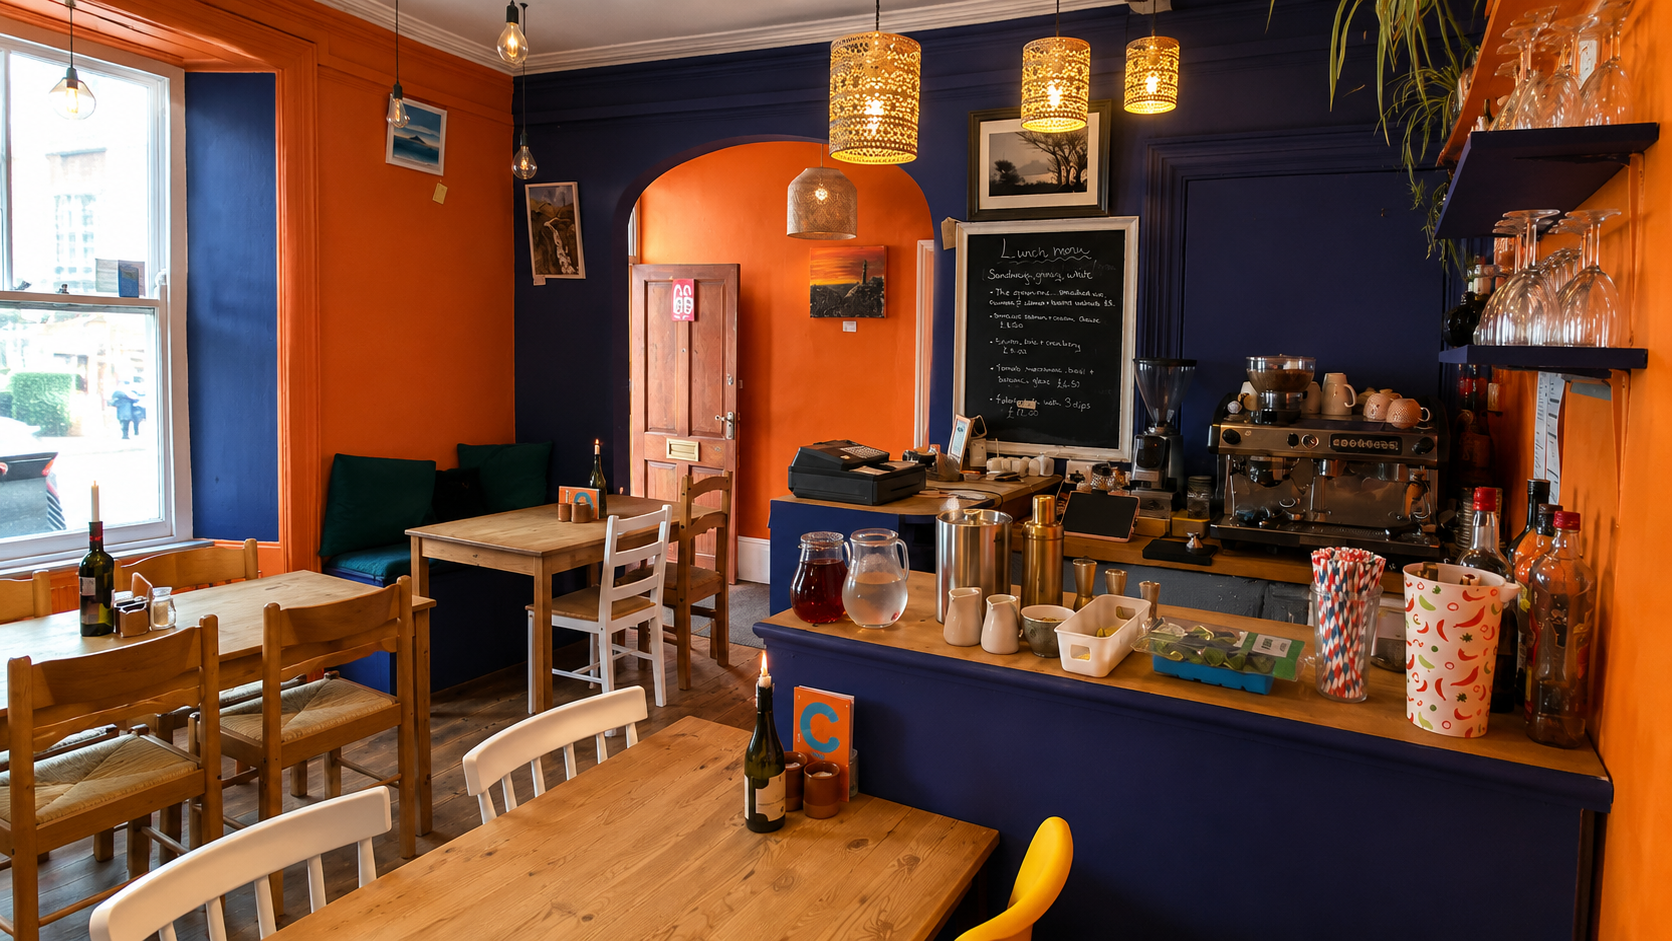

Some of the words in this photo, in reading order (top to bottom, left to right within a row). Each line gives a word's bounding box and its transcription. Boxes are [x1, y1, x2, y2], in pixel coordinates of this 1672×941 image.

[1001, 238, 1048, 259] Lunch
[1064, 397, 1072, 409] 3
[1073, 401, 1091, 412] dips
[800, 702, 840, 753] C
